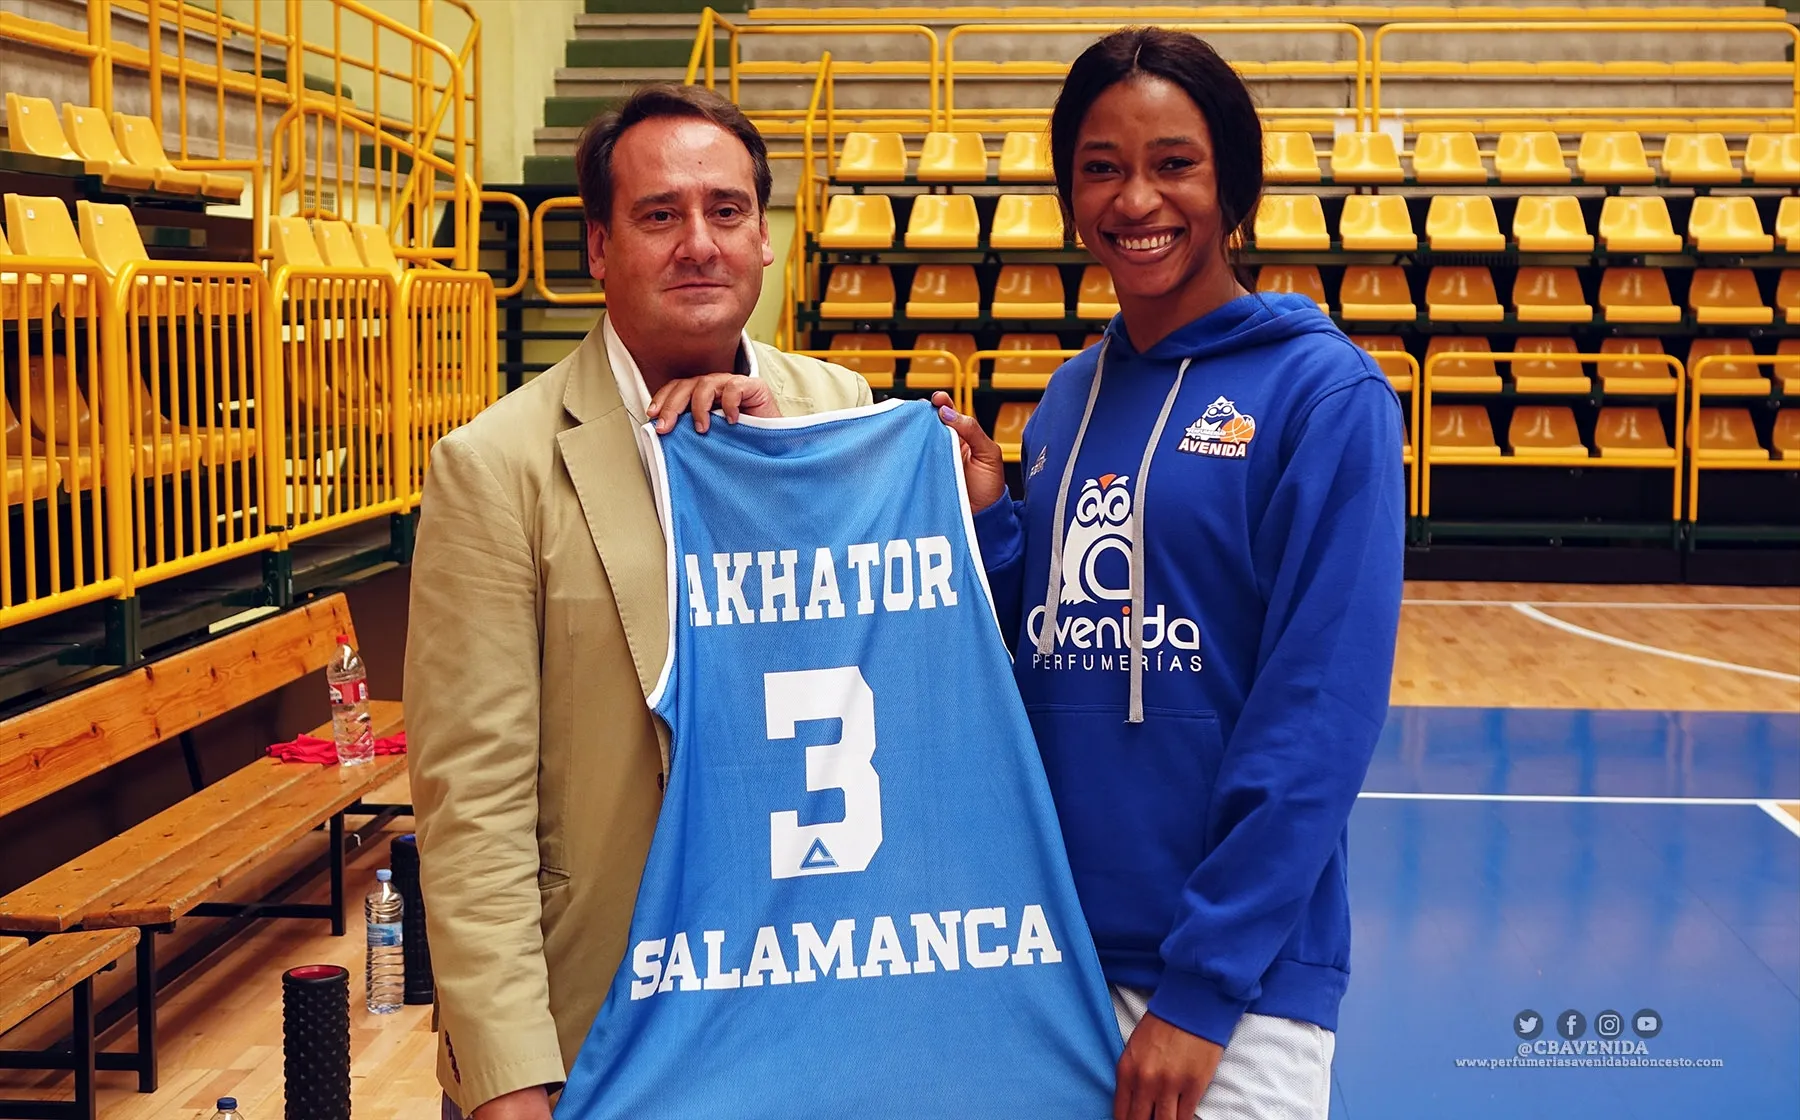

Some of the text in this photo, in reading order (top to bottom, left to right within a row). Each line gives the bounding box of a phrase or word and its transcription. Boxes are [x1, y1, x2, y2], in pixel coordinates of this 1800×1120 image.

[1178, 437, 1247, 457] AVENIDA
[684, 535, 958, 627] AKHATOR
[1032, 651, 1202, 672] PERFUMERÍAS
[763, 665, 883, 880] 3
[630, 904, 1062, 1001] SALAMANCA
